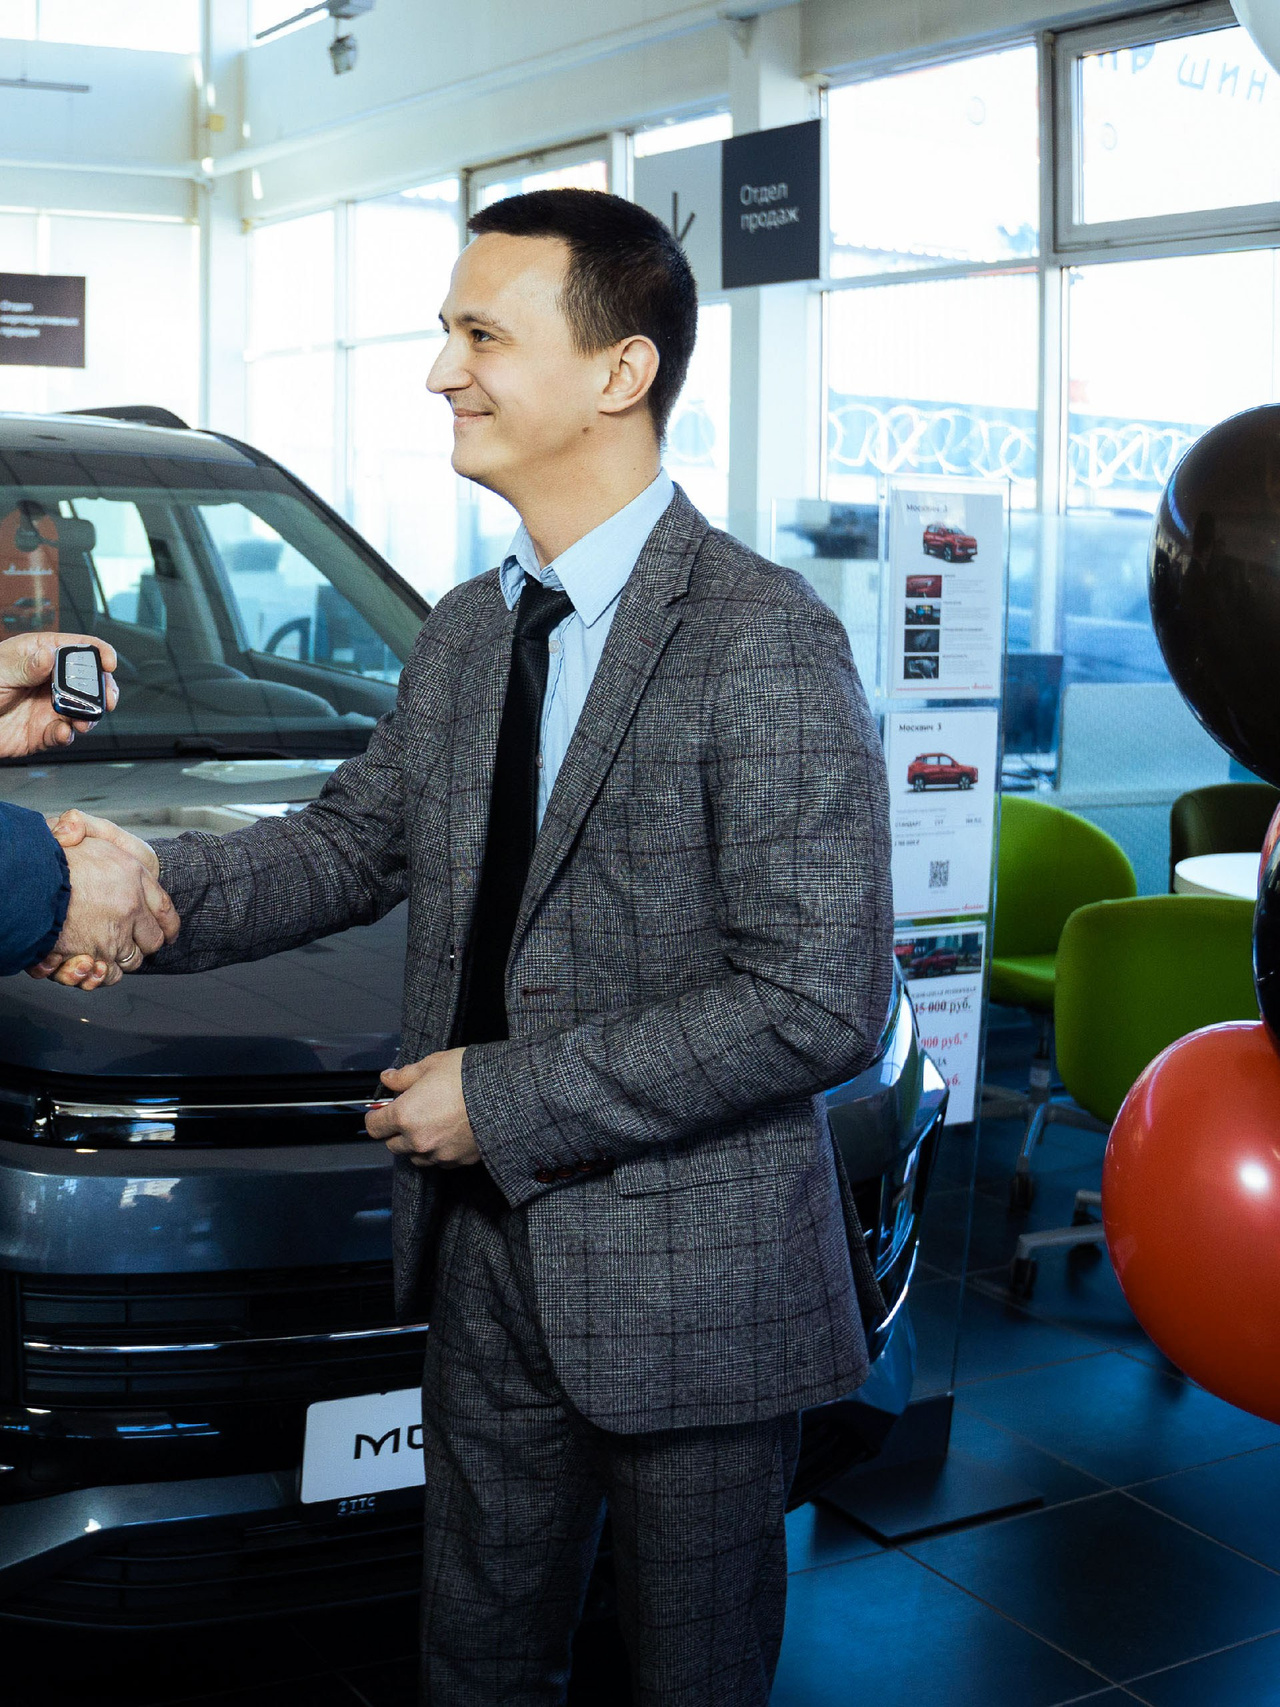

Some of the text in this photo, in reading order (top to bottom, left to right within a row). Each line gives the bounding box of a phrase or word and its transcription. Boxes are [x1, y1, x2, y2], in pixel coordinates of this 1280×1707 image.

[740, 183, 789, 206] Отдел
[740, 206, 800, 234] продаж
[898, 724, 934, 733] Москвич
[950, 996, 971, 1014] руб.
